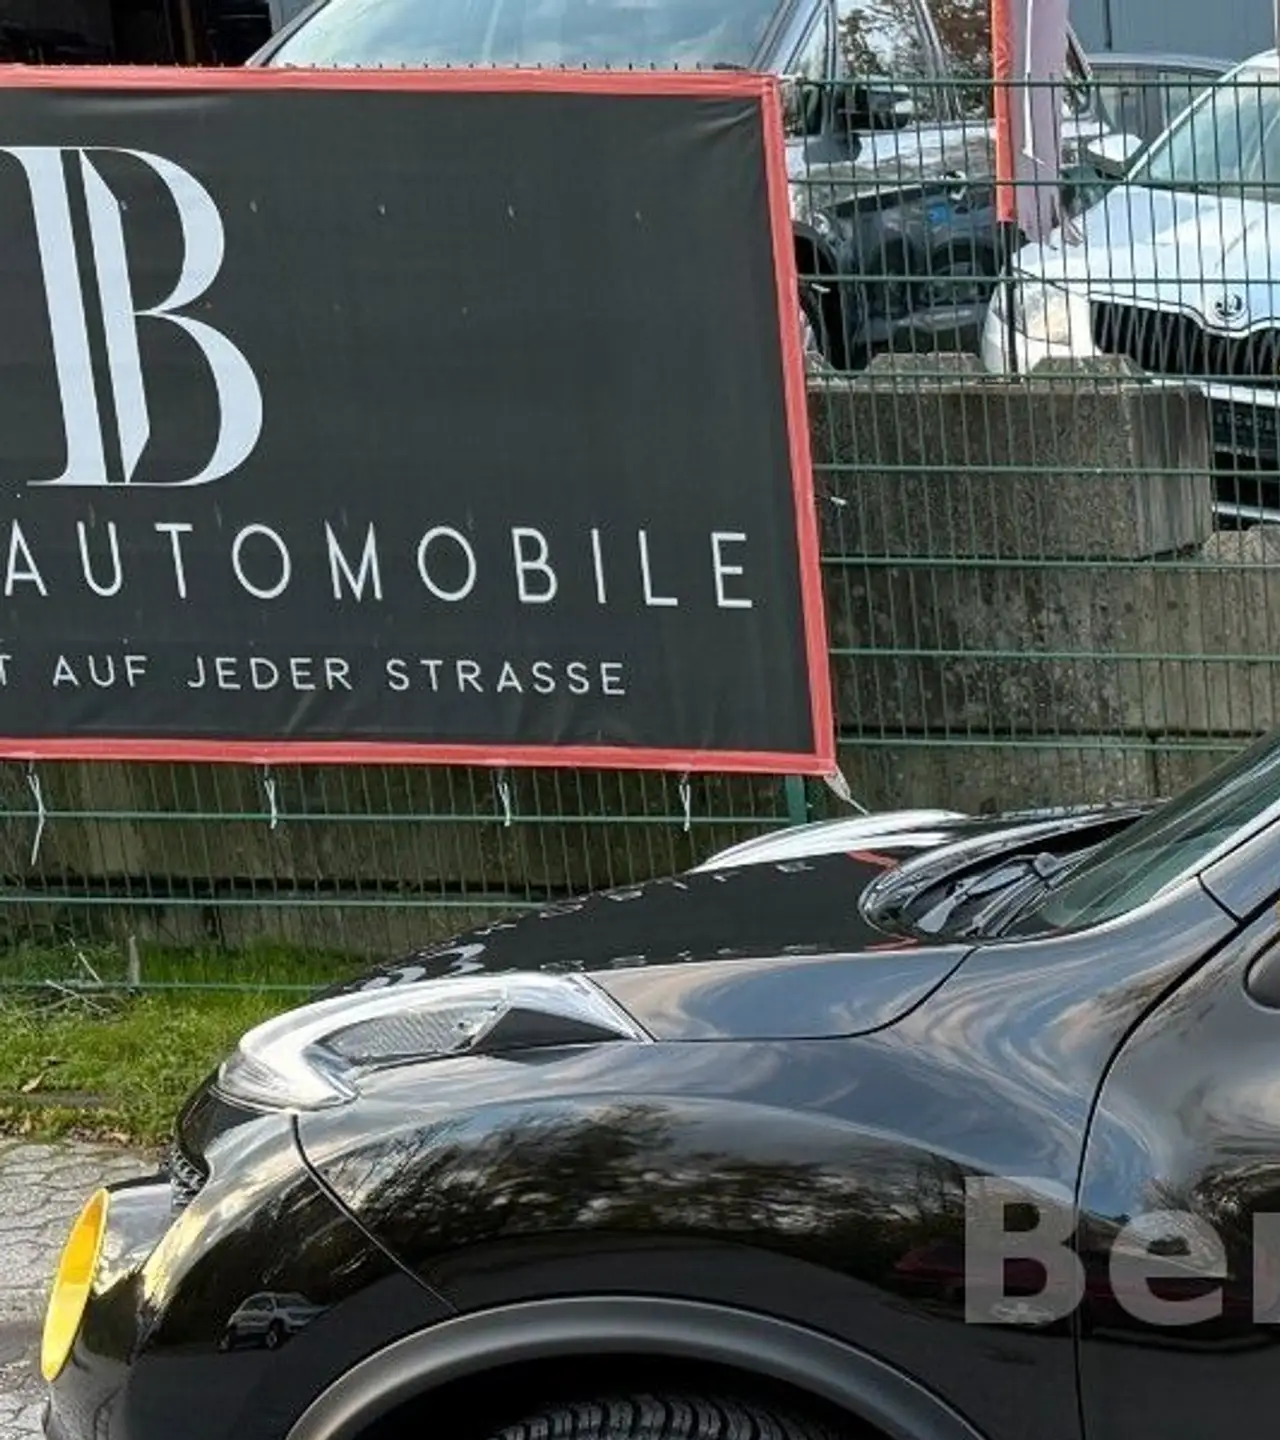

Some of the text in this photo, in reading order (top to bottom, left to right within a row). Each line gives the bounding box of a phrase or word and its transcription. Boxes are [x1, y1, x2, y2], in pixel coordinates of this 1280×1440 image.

[4, 519, 753, 608] AUTOMOBILE
[52, 655, 147, 687] AUF
[187, 656, 352, 690] JEDER
[386, 658, 625, 695] STRASSE
